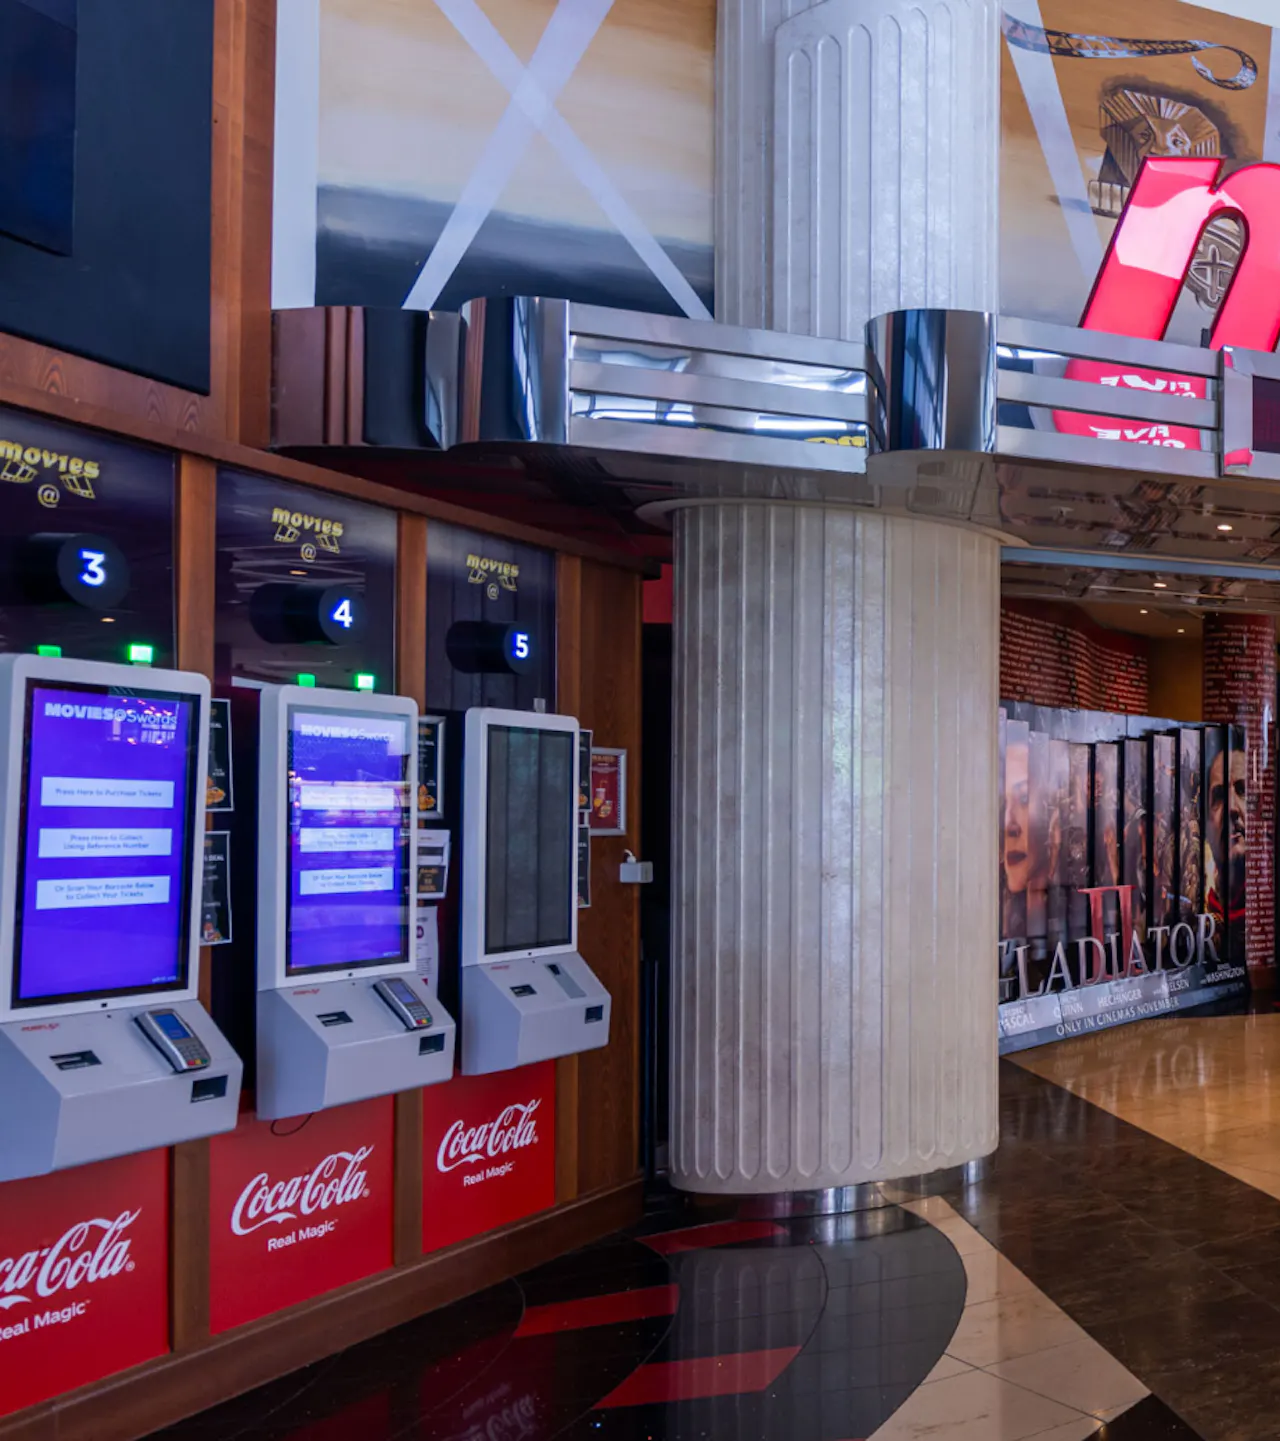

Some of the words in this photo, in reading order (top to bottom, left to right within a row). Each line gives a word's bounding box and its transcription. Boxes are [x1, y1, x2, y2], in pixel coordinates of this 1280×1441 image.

[0, 439, 100, 479] movies
[271, 507, 344, 538] movies
[79, 548, 107, 586] 3
[332, 599, 355, 629] 4
[515, 633, 530, 660] 5
[1056, 1019, 1082, 1036] ONLY
[1084, 1017, 1095, 1029] IN
[1096, 1005, 1137, 1026] CINEMAS
[436, 1097, 542, 1174] Coca-Cola
[231, 1145, 375, 1237] Coca-Cola
[463, 1173, 485, 1188] Real
[485, 1162, 514, 1179] Magic
[267, 1228, 297, 1252] Real
[299, 1219, 336, 1242] Magic
[0, 1206, 143, 1310] ca-Cola
[0, 1317, 31, 1342] eal
[33, 1300, 88, 1330] Magic
